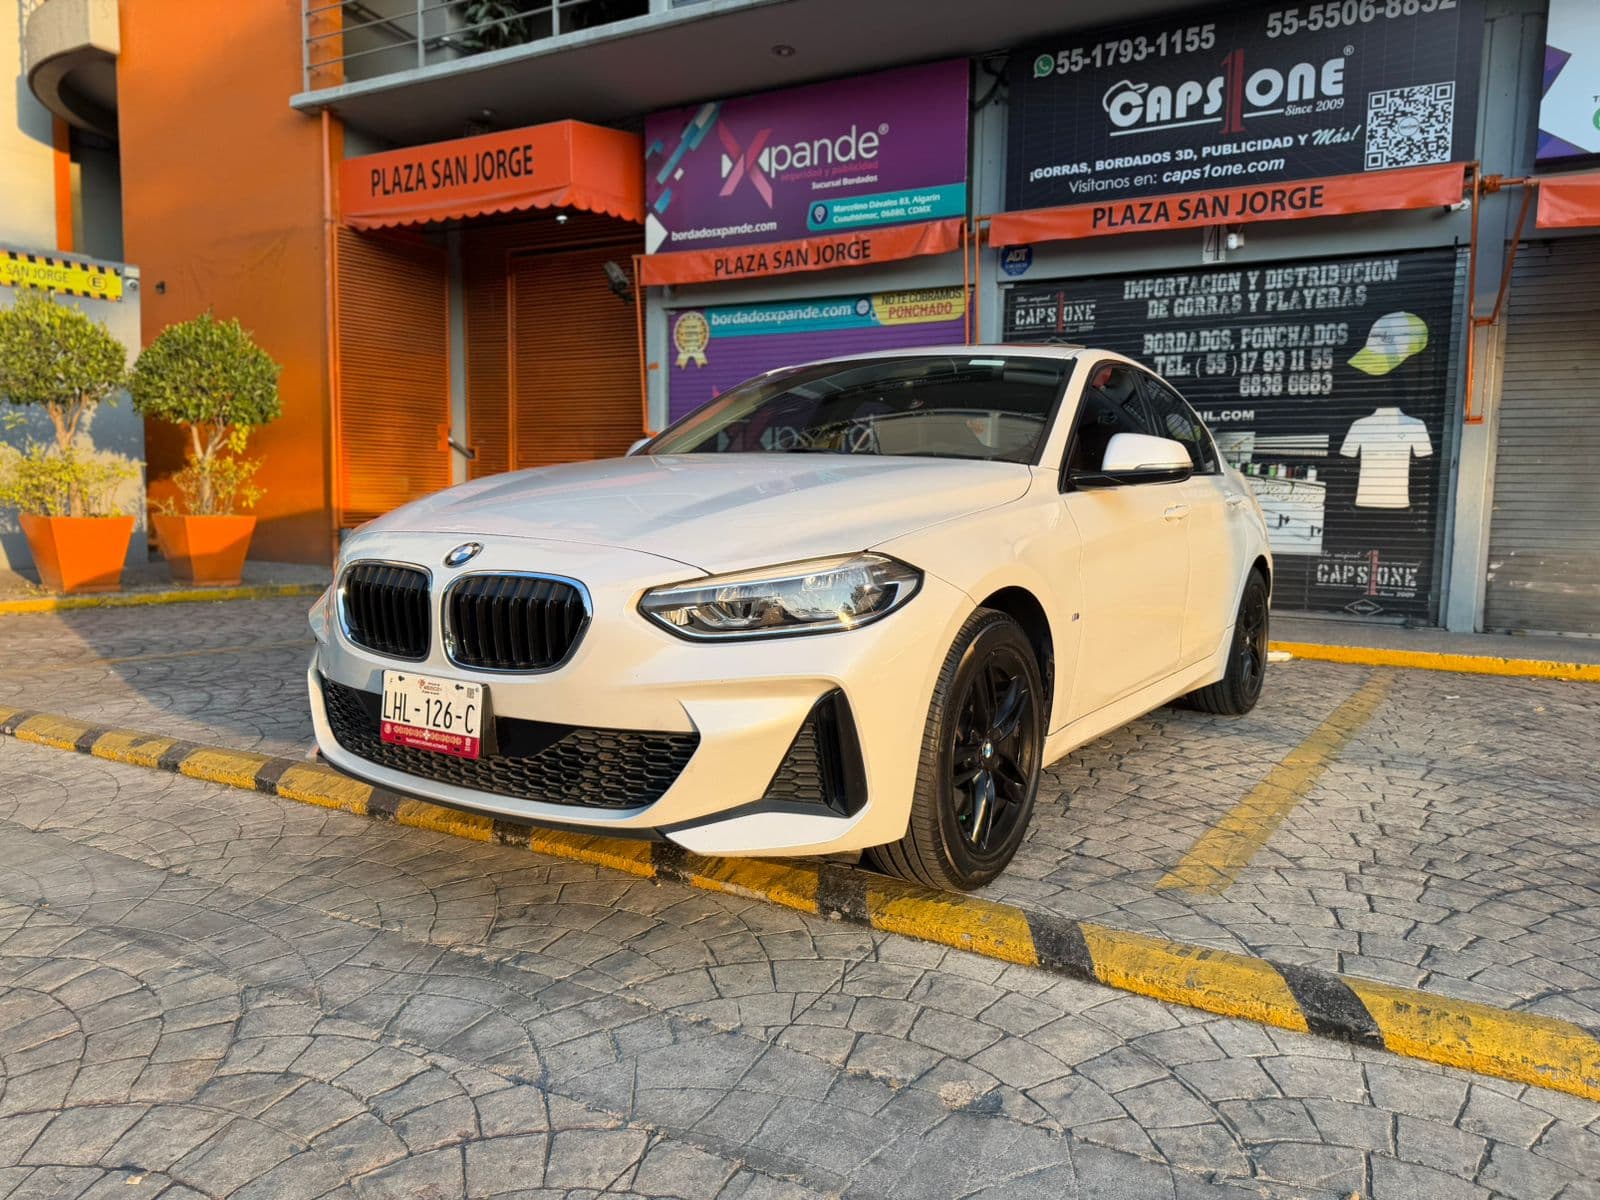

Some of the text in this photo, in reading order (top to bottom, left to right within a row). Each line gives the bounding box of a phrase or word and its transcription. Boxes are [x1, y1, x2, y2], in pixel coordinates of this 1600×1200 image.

[1056, 24, 1216, 75] 55-1793-1155
[1284, 97, 1345, 117] Since 2009
[1030, 124, 1361, 183] ¡GORRAS, BORDADOS 3D, PUBLICIDAD Y Más!
[371, 144, 534, 197] PLAZA SAN JORGE
[842, 174, 878, 187] Bordados
[1069, 157, 1285, 195] Visítanos en: caps1one.com
[1092, 185, 1324, 229] PLAZA SAN JORGE
[671, 221, 777, 241] bordadosxpande.com
[714, 239, 871, 277] PLAZA SAN JORGE
[1006, 248, 1029, 263] ADT
[6, 262, 30, 277] SAN
[33, 267, 70, 283] JORGE
[92, 277, 101, 287] E
[1123, 259, 1399, 299] IMPORTACION Y DISTRIBUCION
[711, 304, 851, 325] bordadosxpande.com
[888, 302, 952, 319] PONCHADO
[1147, 285, 1367, 319] DE GORRAS Y PLAYERAS
[1240, 322, 1348, 349] PONCHADOS
[1154, 355, 1191, 377] TEL:
[1240, 352, 1257, 372] 17
[1262, 351, 1285, 371] 93
[1289, 350, 1305, 371] 11
[1311, 348, 1333, 369] 55
[1239, 374, 1283, 396] 6838
[383, 690, 475, 734] LHL-126-C
